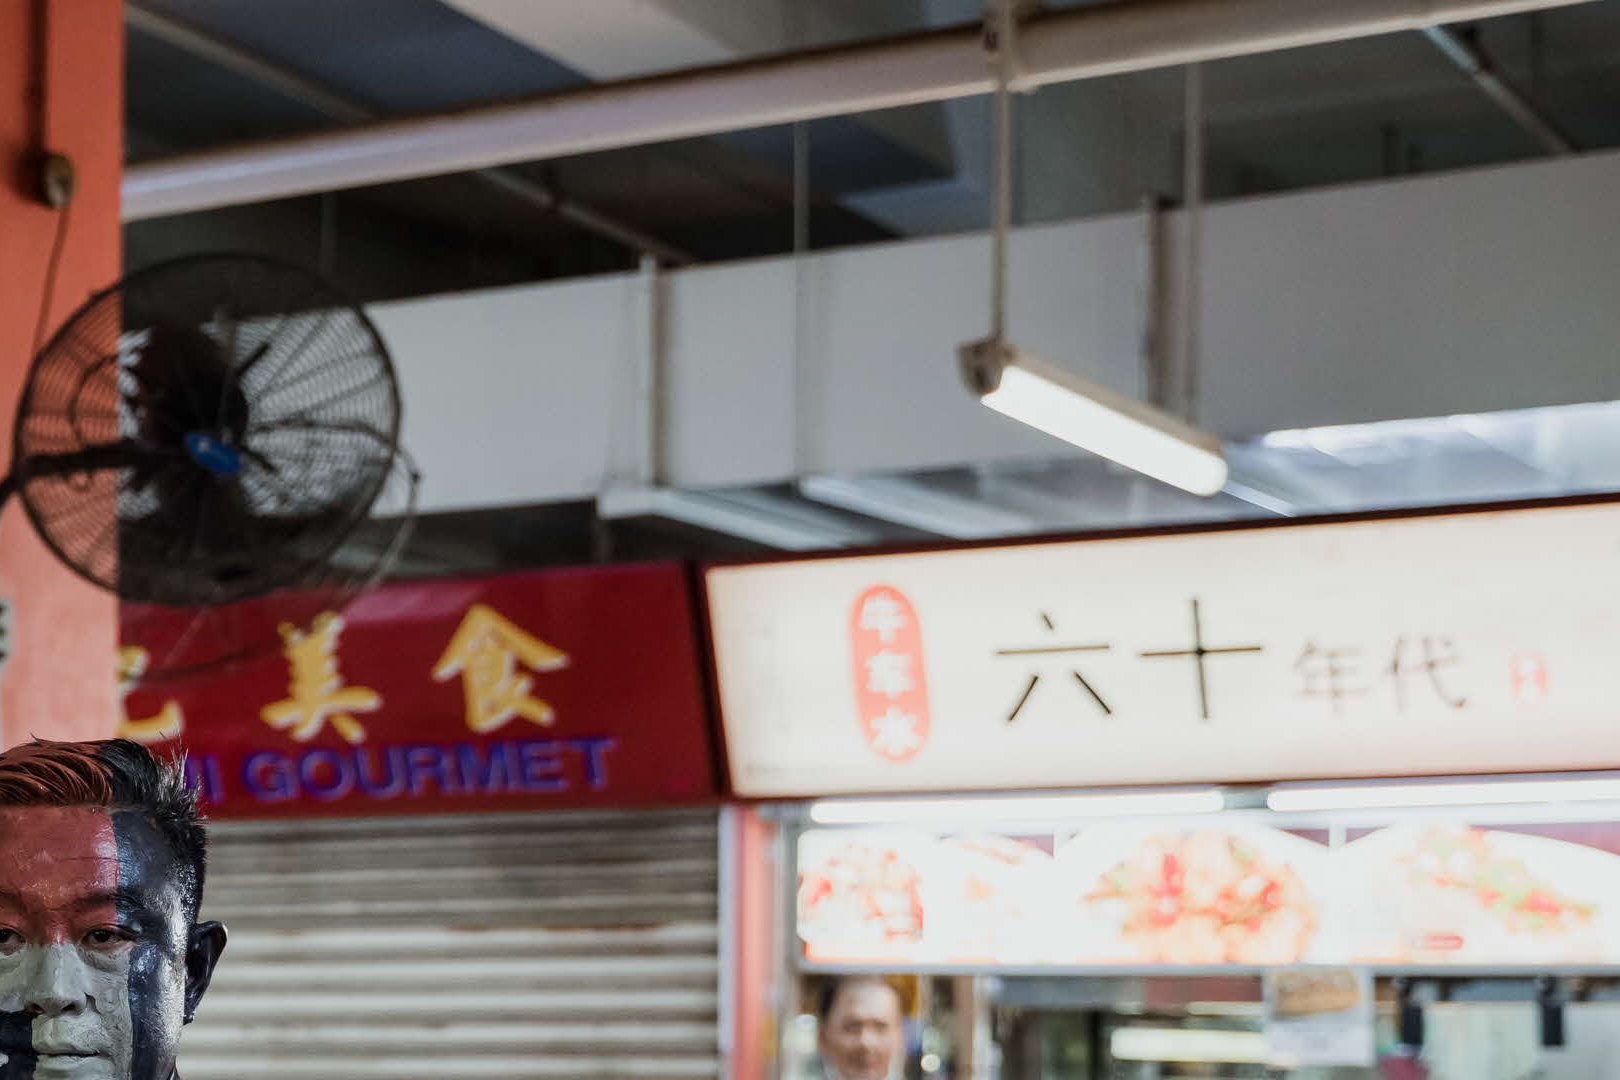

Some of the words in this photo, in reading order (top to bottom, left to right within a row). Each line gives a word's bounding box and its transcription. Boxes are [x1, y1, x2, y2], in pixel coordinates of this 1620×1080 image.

[993, 597, 1468, 721] 六十年代
[244, 736, 618, 803] GOURMET
